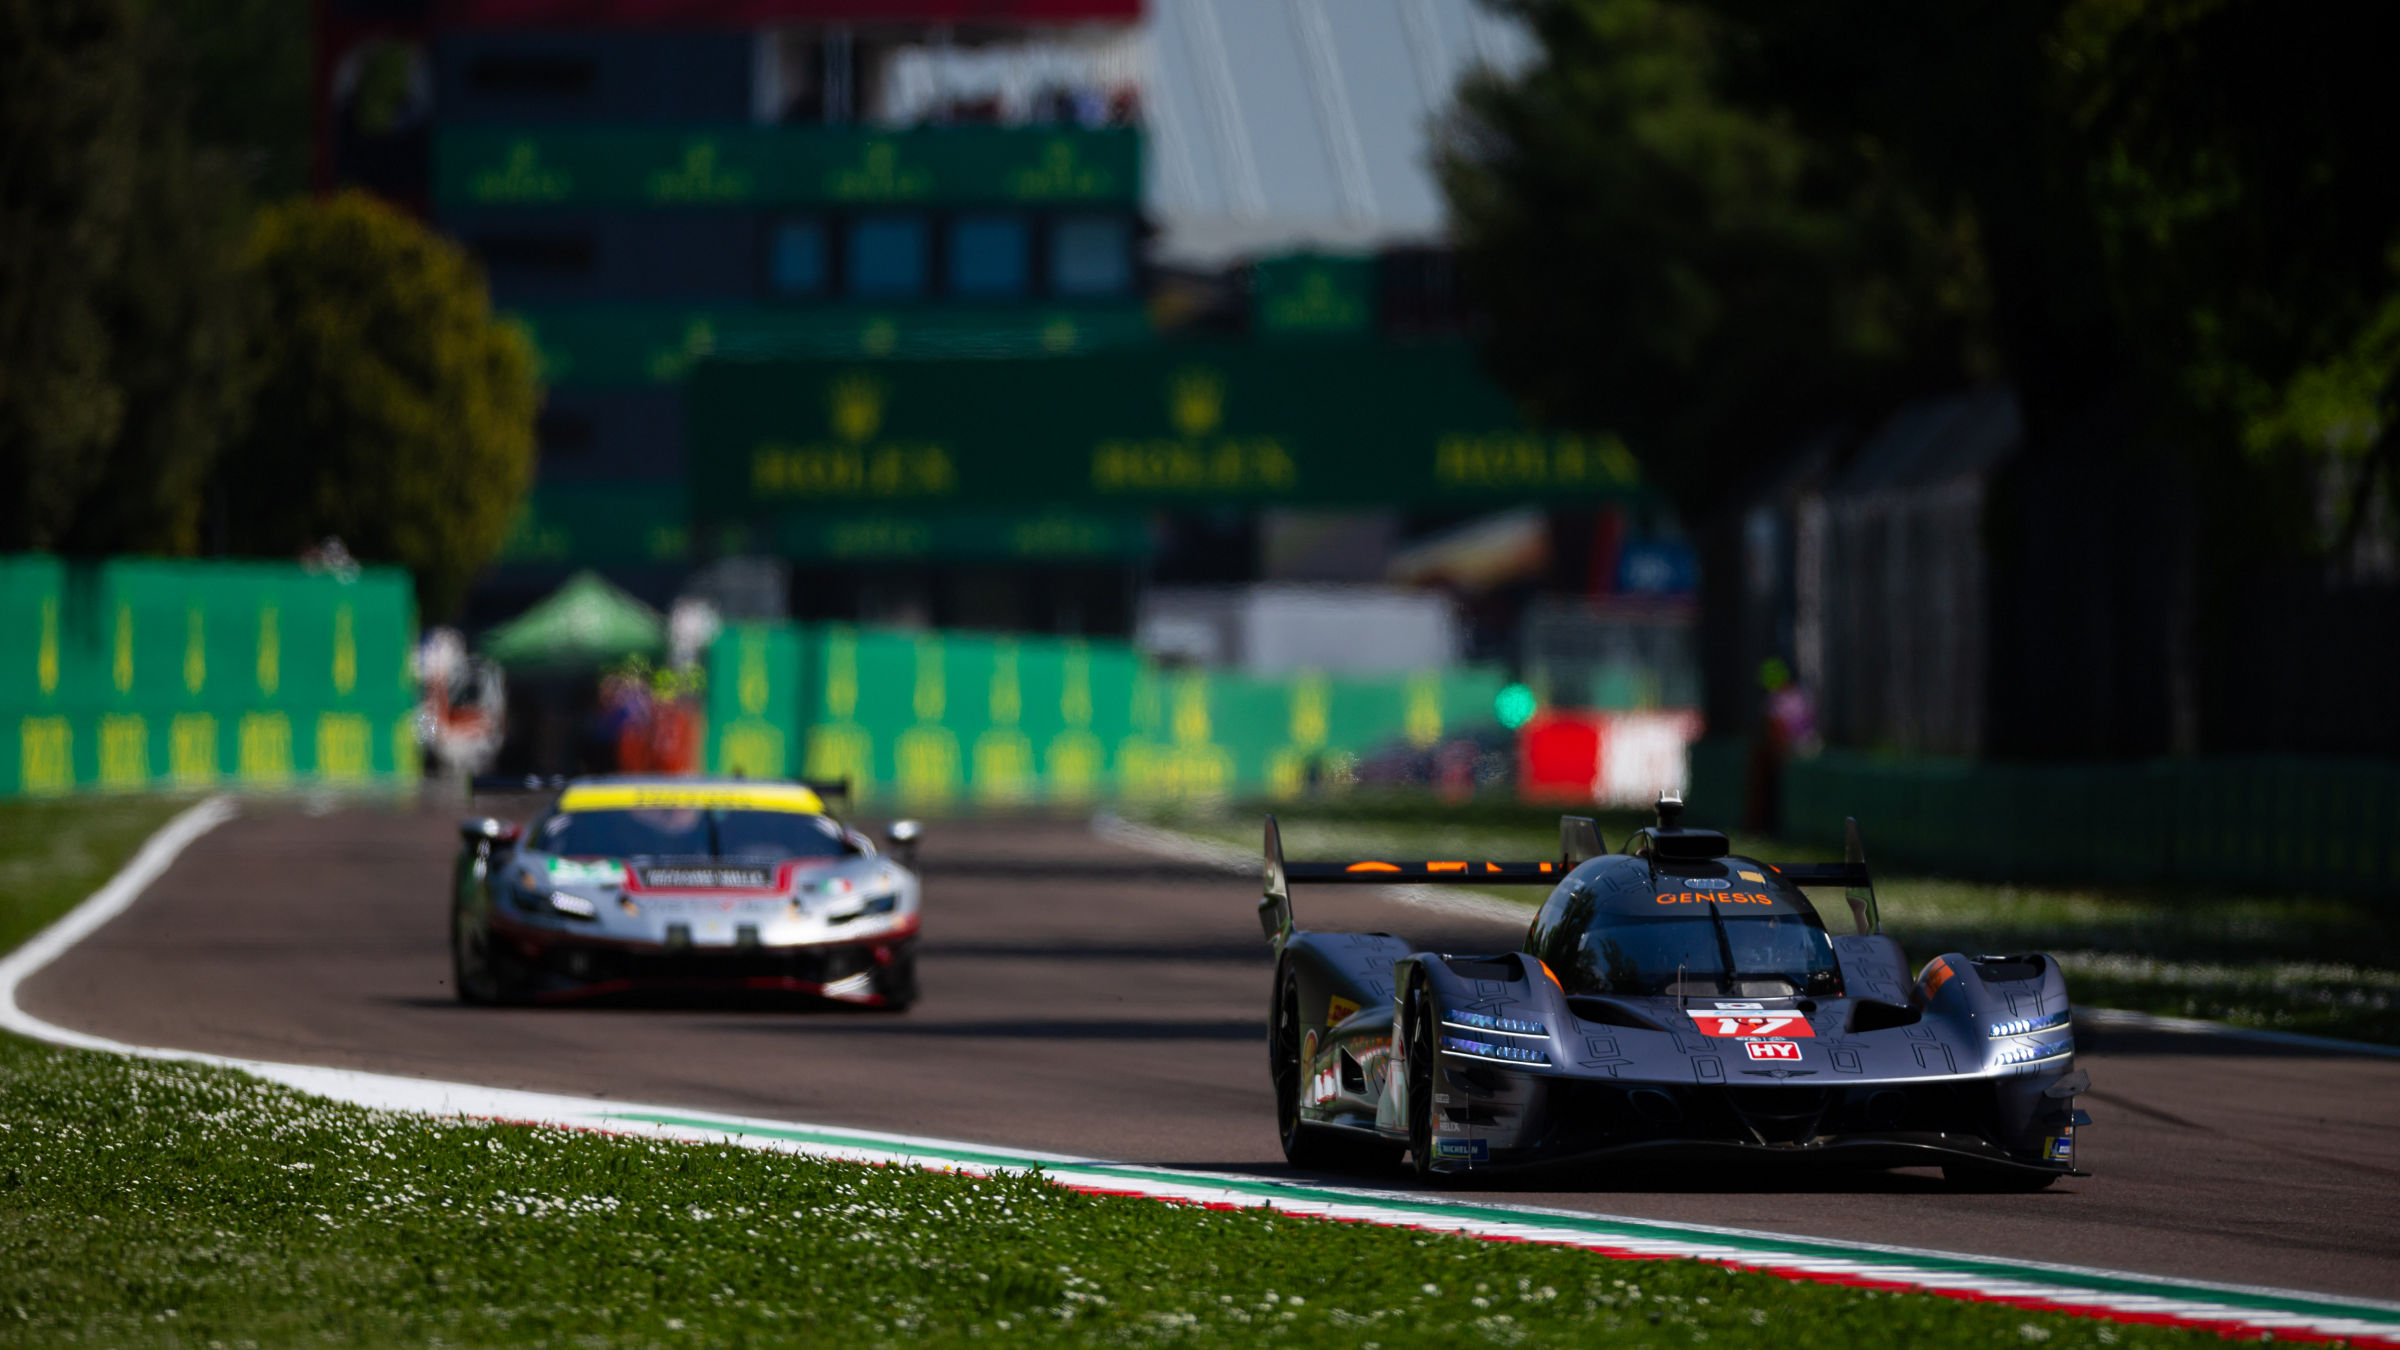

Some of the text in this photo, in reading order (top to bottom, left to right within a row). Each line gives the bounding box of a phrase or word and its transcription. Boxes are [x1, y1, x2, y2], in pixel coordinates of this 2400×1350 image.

[1656, 892, 1773, 906] GENESIS
[1717, 1017, 1793, 1035] 17
[1750, 1043, 1793, 1058] HY
[1443, 1144, 1479, 1154] MICHELN
